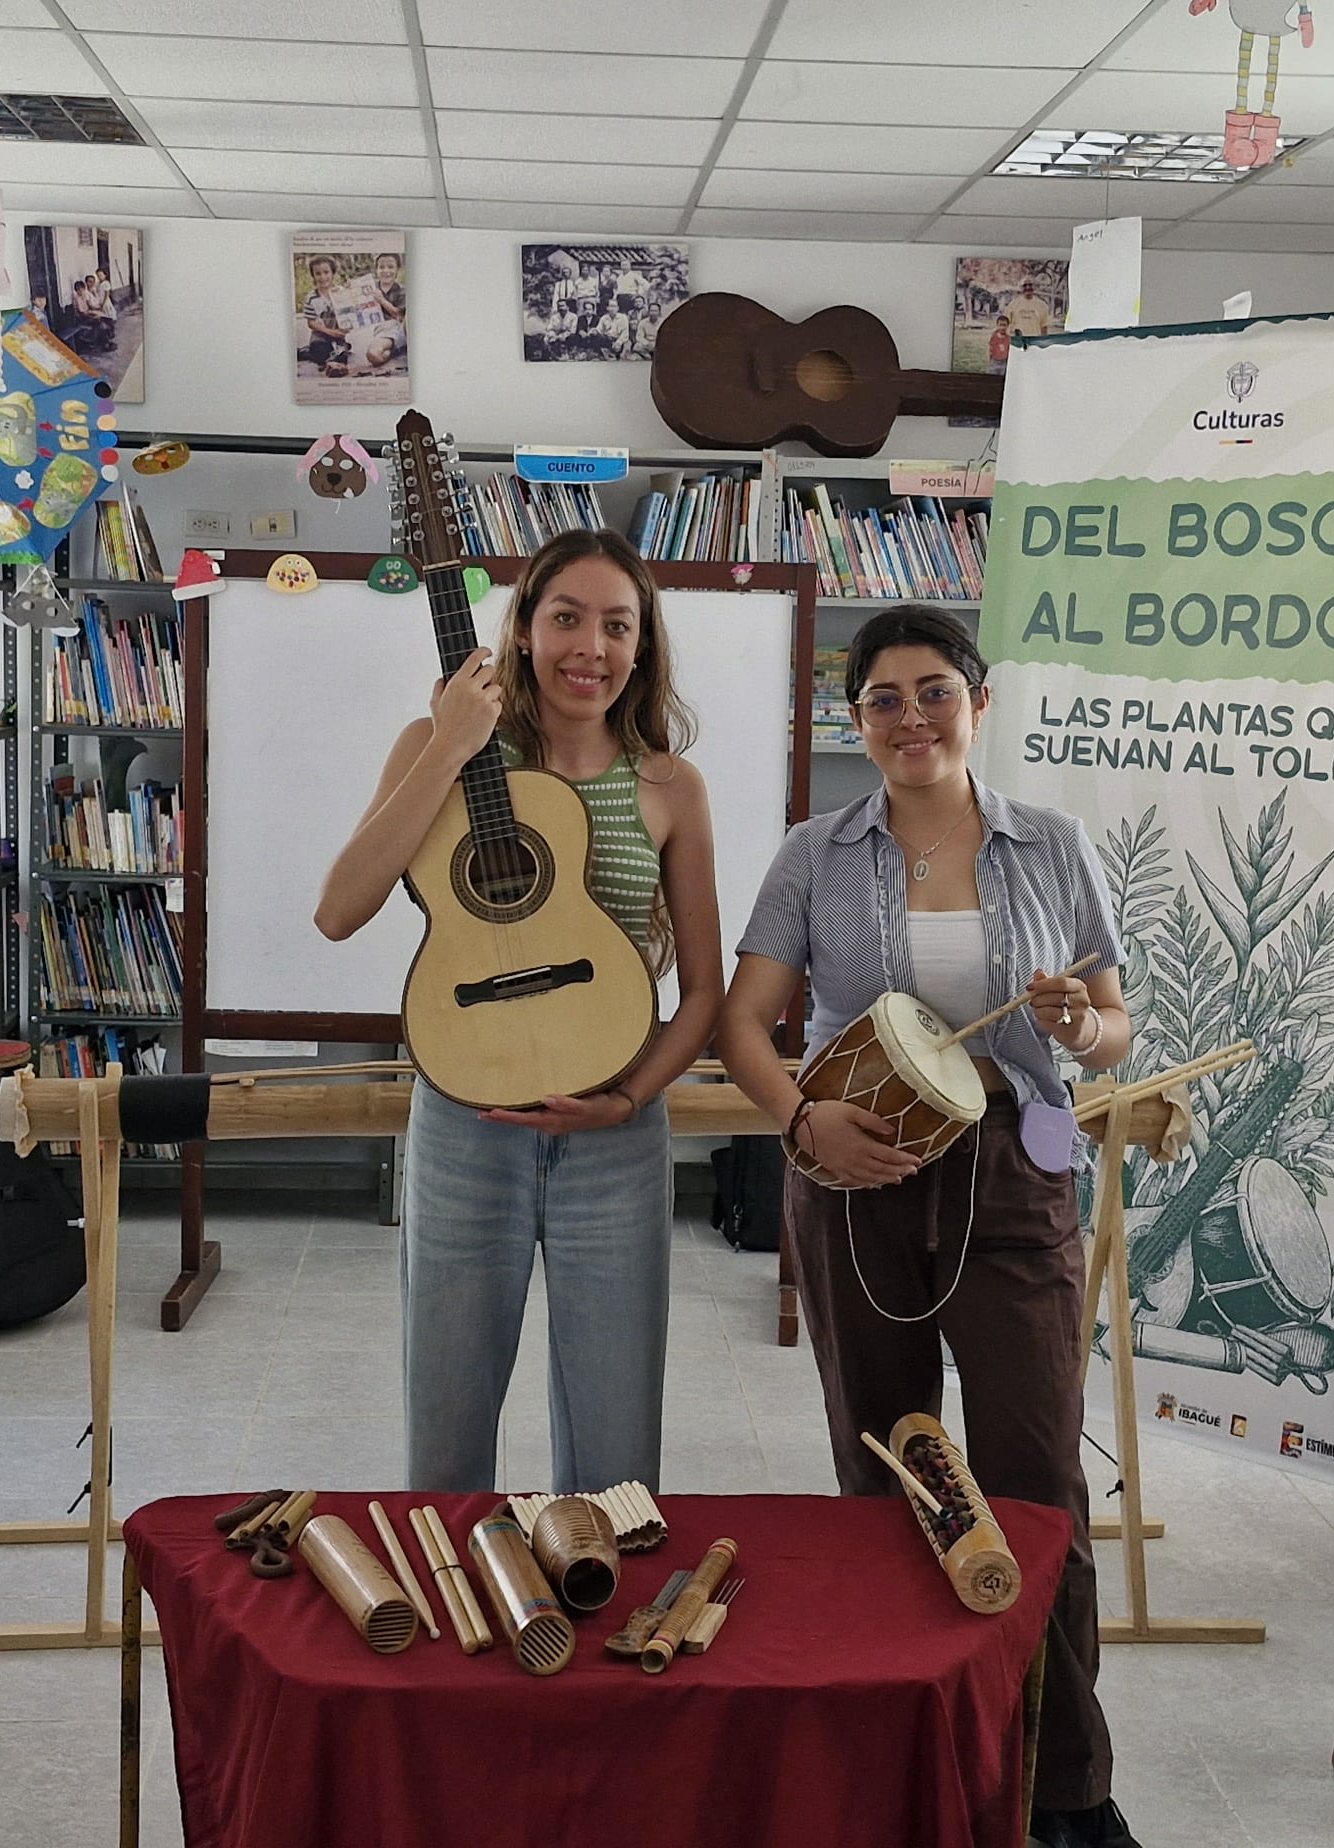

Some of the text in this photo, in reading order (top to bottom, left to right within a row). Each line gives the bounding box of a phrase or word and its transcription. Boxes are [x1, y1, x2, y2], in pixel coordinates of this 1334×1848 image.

[1192, 409, 1284, 431] Culturas
[547, 462, 595, 473] CUENTO
[921, 476, 962, 488] POESÍA
[1021, 505, 1146, 558] DEL
[1021, 590, 1104, 645] AL
[1039, 695, 1111, 729] LAS
[1122, 698, 1294, 738] PLANTAS
[1024, 732, 1172, 773] SUENAN
[1184, 742, 1235, 776] AL
[1178, 1408, 1221, 1428] IBAGUÉ
